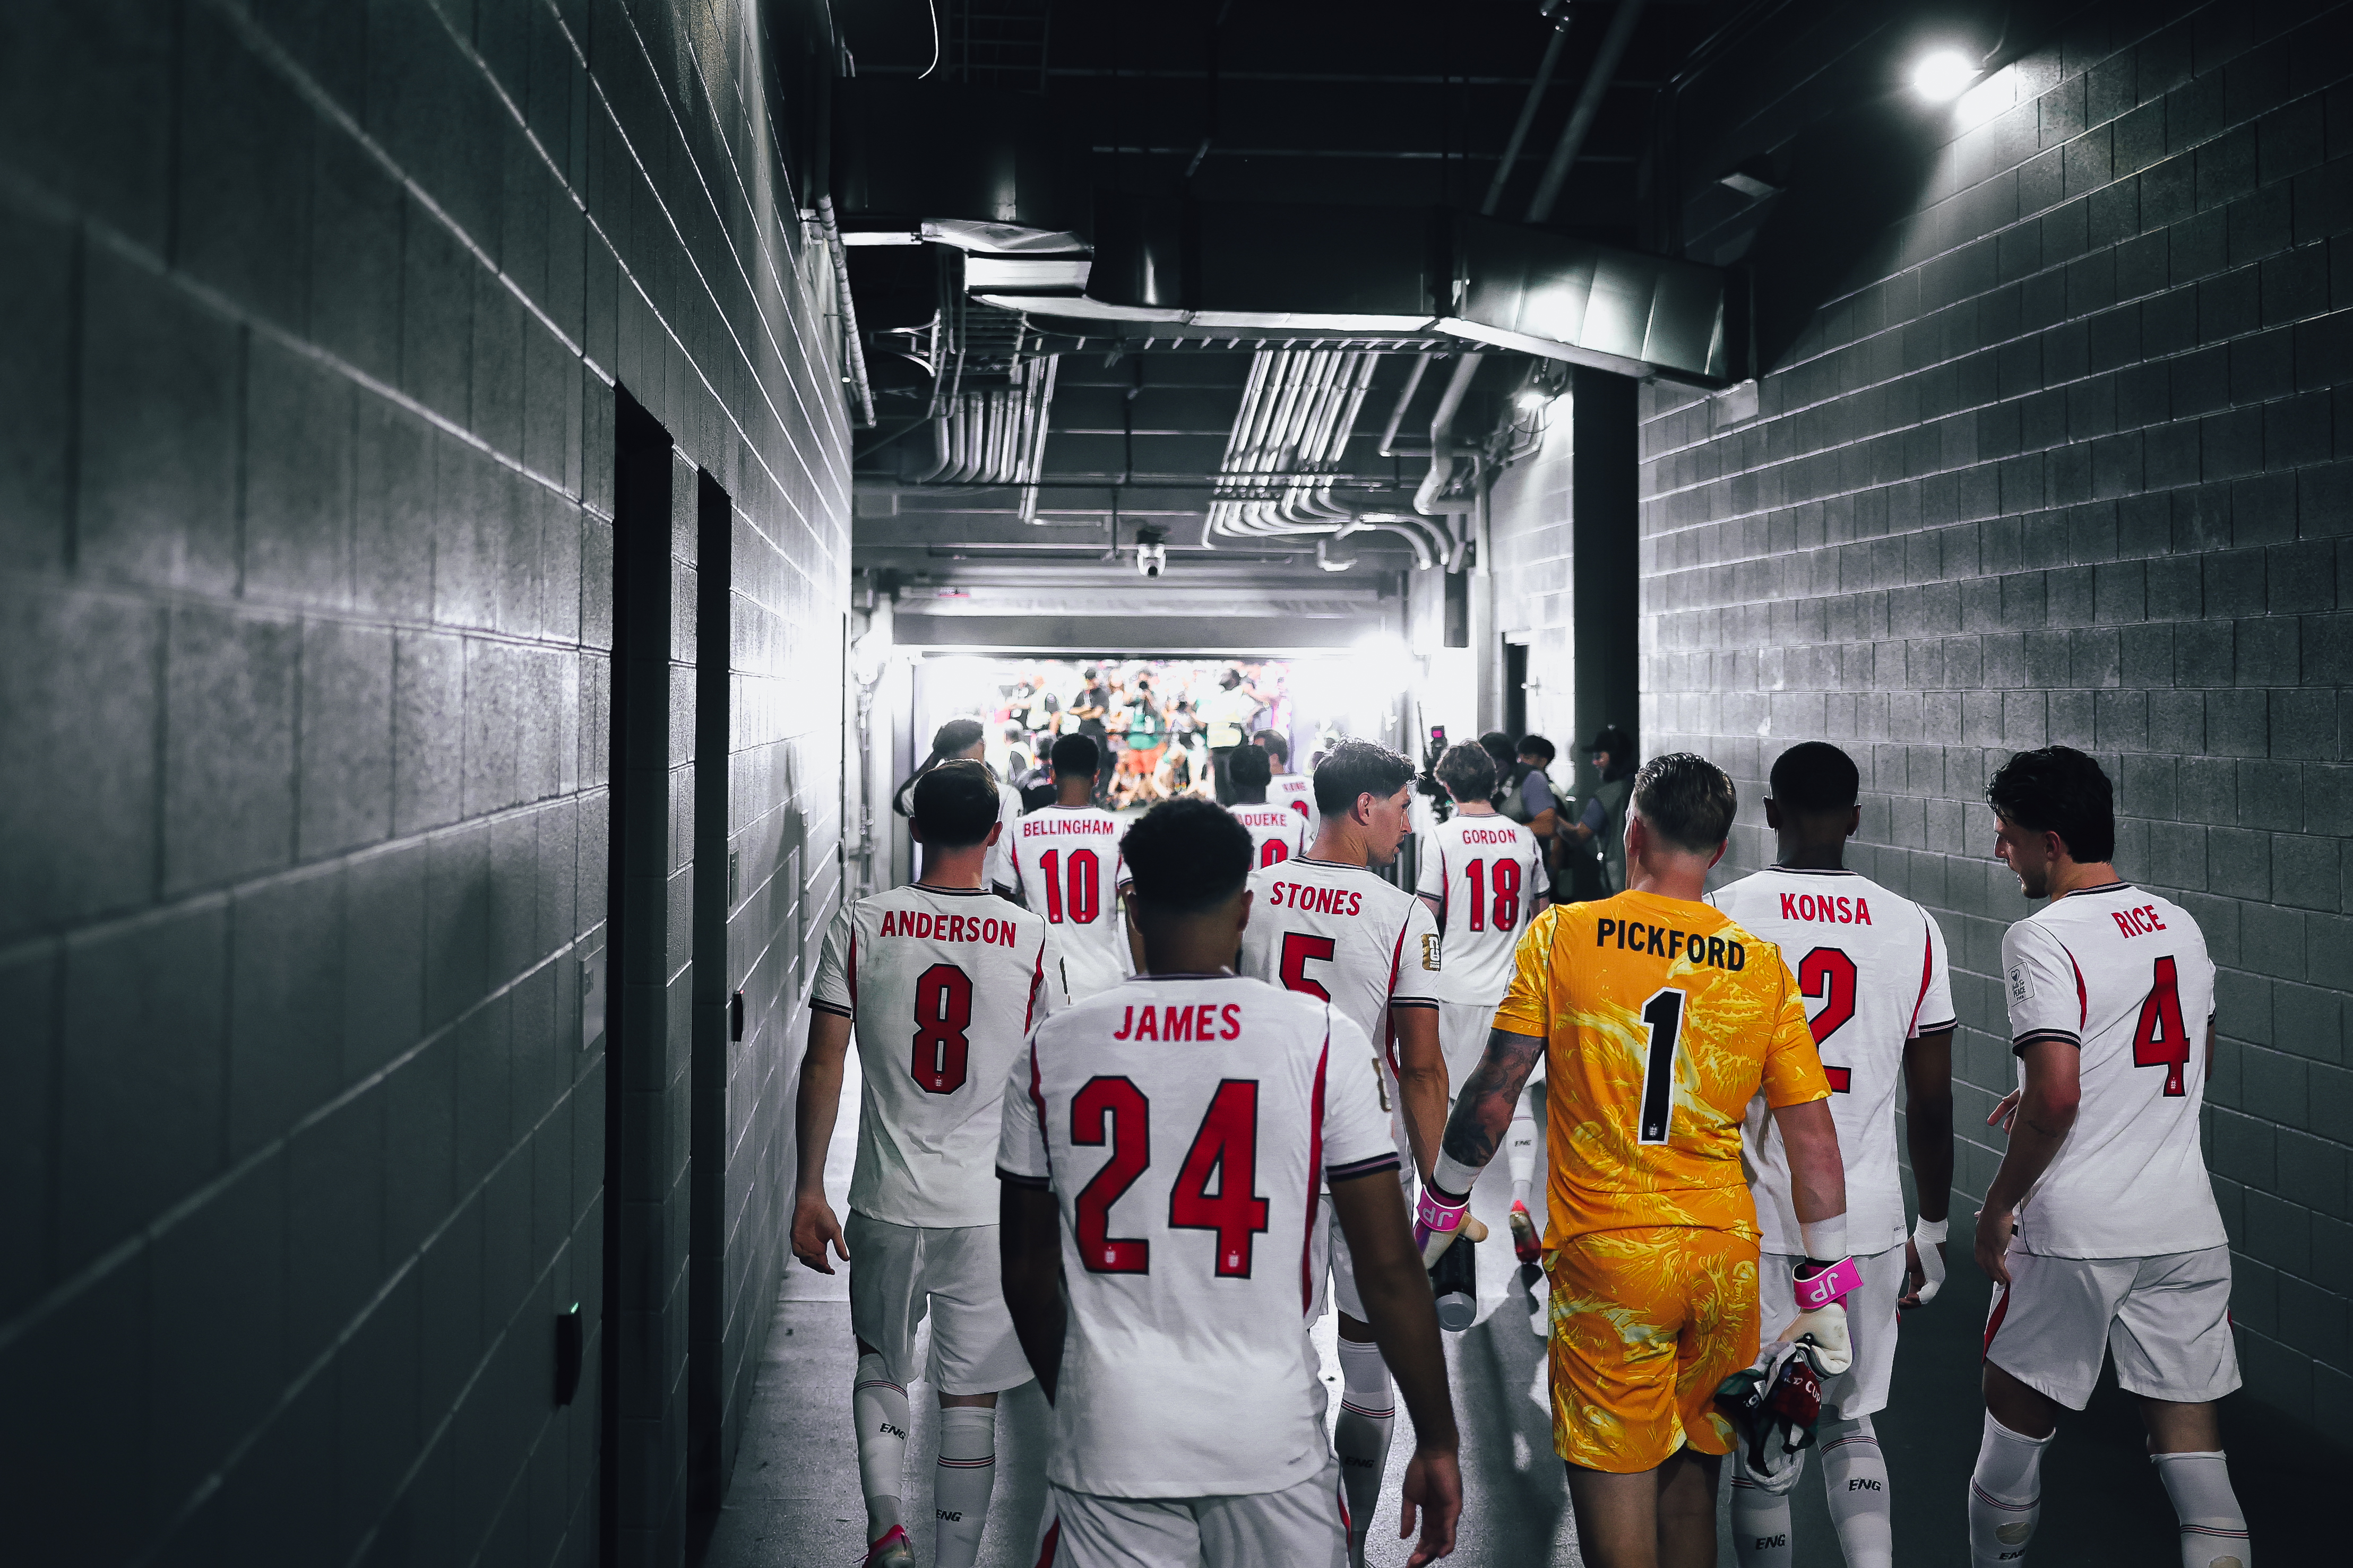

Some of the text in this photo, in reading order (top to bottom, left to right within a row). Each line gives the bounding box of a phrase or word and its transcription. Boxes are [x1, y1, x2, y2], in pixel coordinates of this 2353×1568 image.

[1023, 819, 1114, 838] BELLINGHAM
[1462, 829, 1517, 844] GORDON
[1040, 849, 1099, 923] 10
[1270, 881, 1363, 916] STONES
[1466, 858, 1521, 932] 18
[1780, 893, 1873, 925] KONSA
[2111, 904, 2167, 939] RICE
[880, 910, 1016, 949] ANDERSON
[1596, 917, 1746, 972] PICKFORD
[1279, 931, 1336, 1004] 5
[910, 963, 973, 1096] 8
[1114, 1003, 1242, 1042] JAMES
[1798, 946, 1857, 1094] 2
[2132, 955, 2191, 1097] 4
[1637, 986, 1686, 1146] 1
[1071, 1075, 1270, 1279] 24
[1423, 1206, 1453, 1227] JP
[1810, 1272, 1840, 1302] JP
[880, 1423, 906, 1440] ENG
[1344, 1456, 1375, 1469] ENG
[1849, 1478, 1882, 1493] ENG
[936, 1509, 963, 1523] ENG
[1755, 1534, 1786, 1550] ENG
